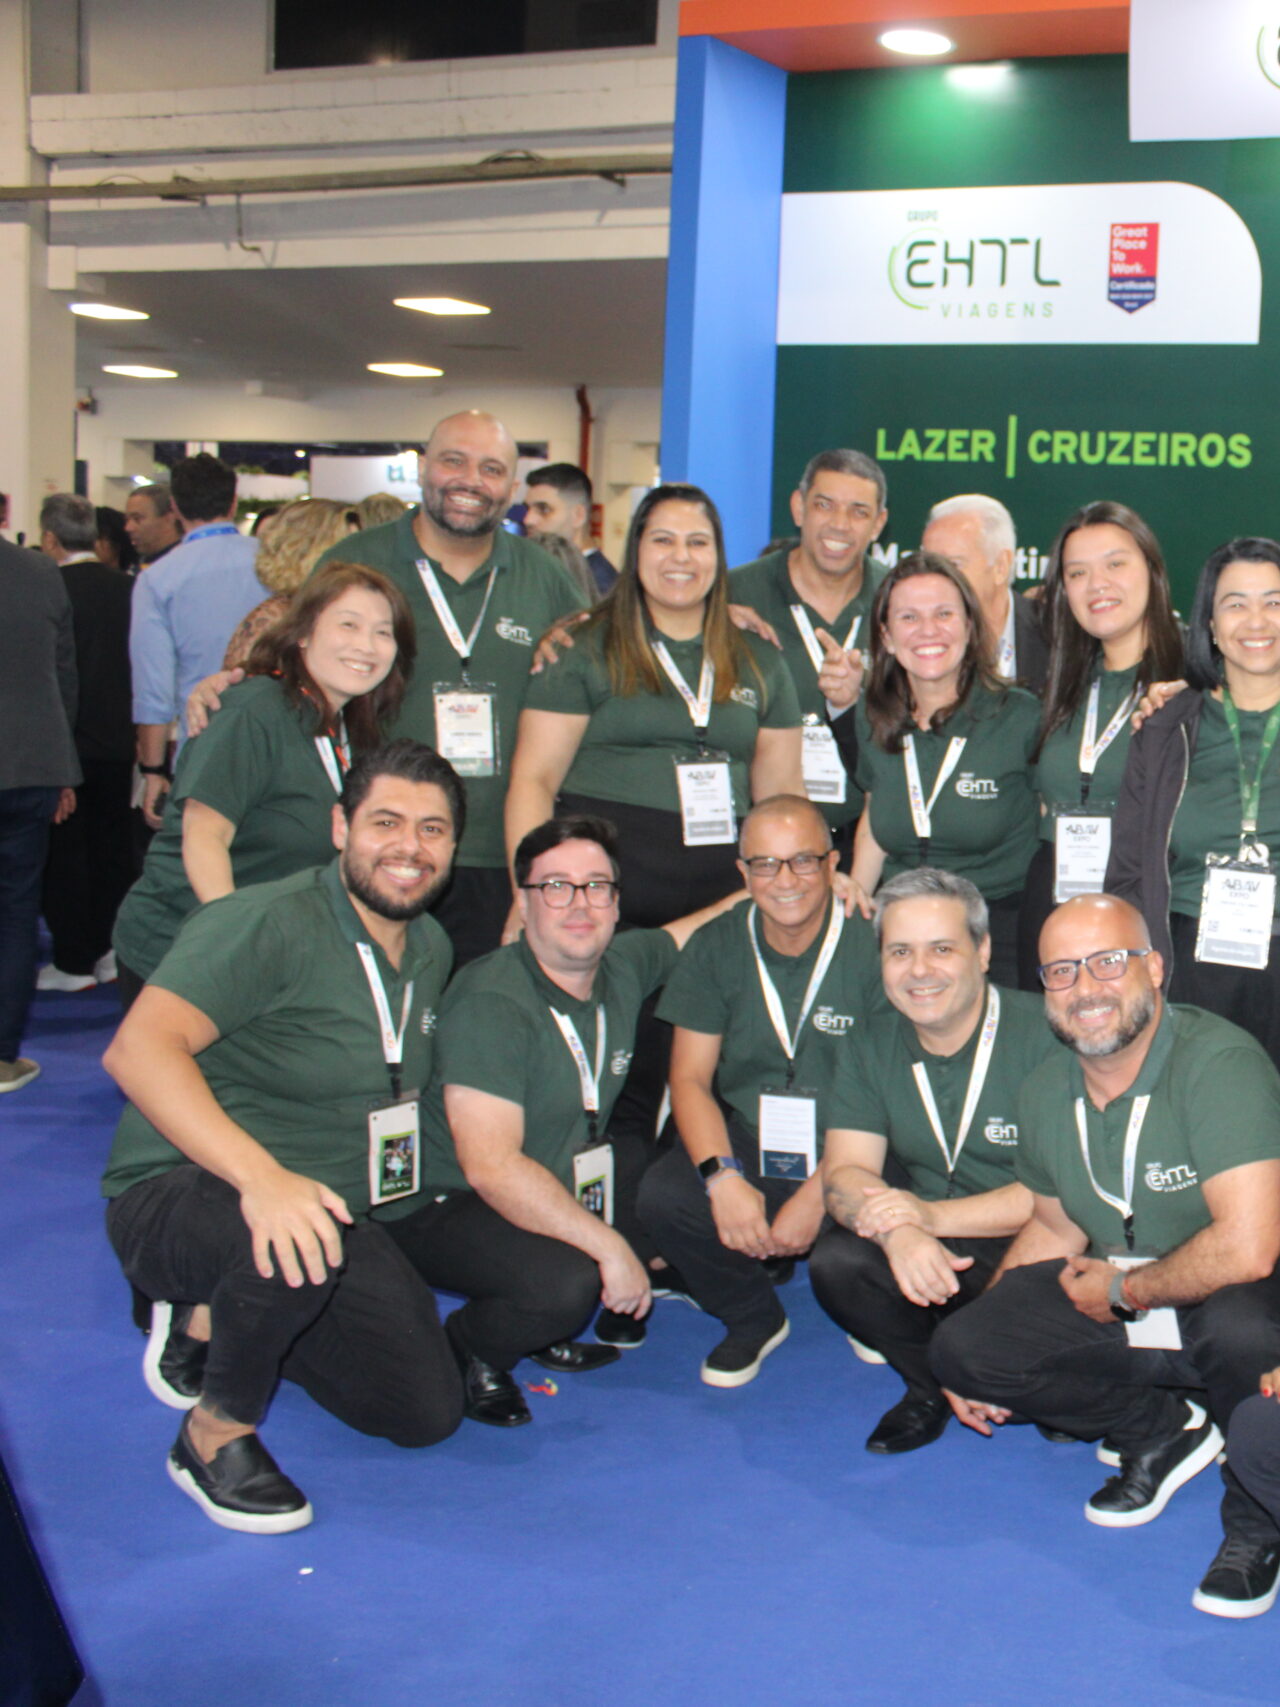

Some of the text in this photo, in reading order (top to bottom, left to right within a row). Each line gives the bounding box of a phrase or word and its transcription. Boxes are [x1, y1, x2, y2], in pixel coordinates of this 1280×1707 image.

[1112, 225, 1149, 238] Great
[1112, 238, 1148, 250] Place
[906, 237, 1062, 288] EHTL
[1112, 249, 1127, 262] To
[940, 301, 1054, 319] VIAGENS
[876, 428, 1252, 468] LAZER CRUZEIROS
[1150, 1164, 1198, 1187] EHTL
